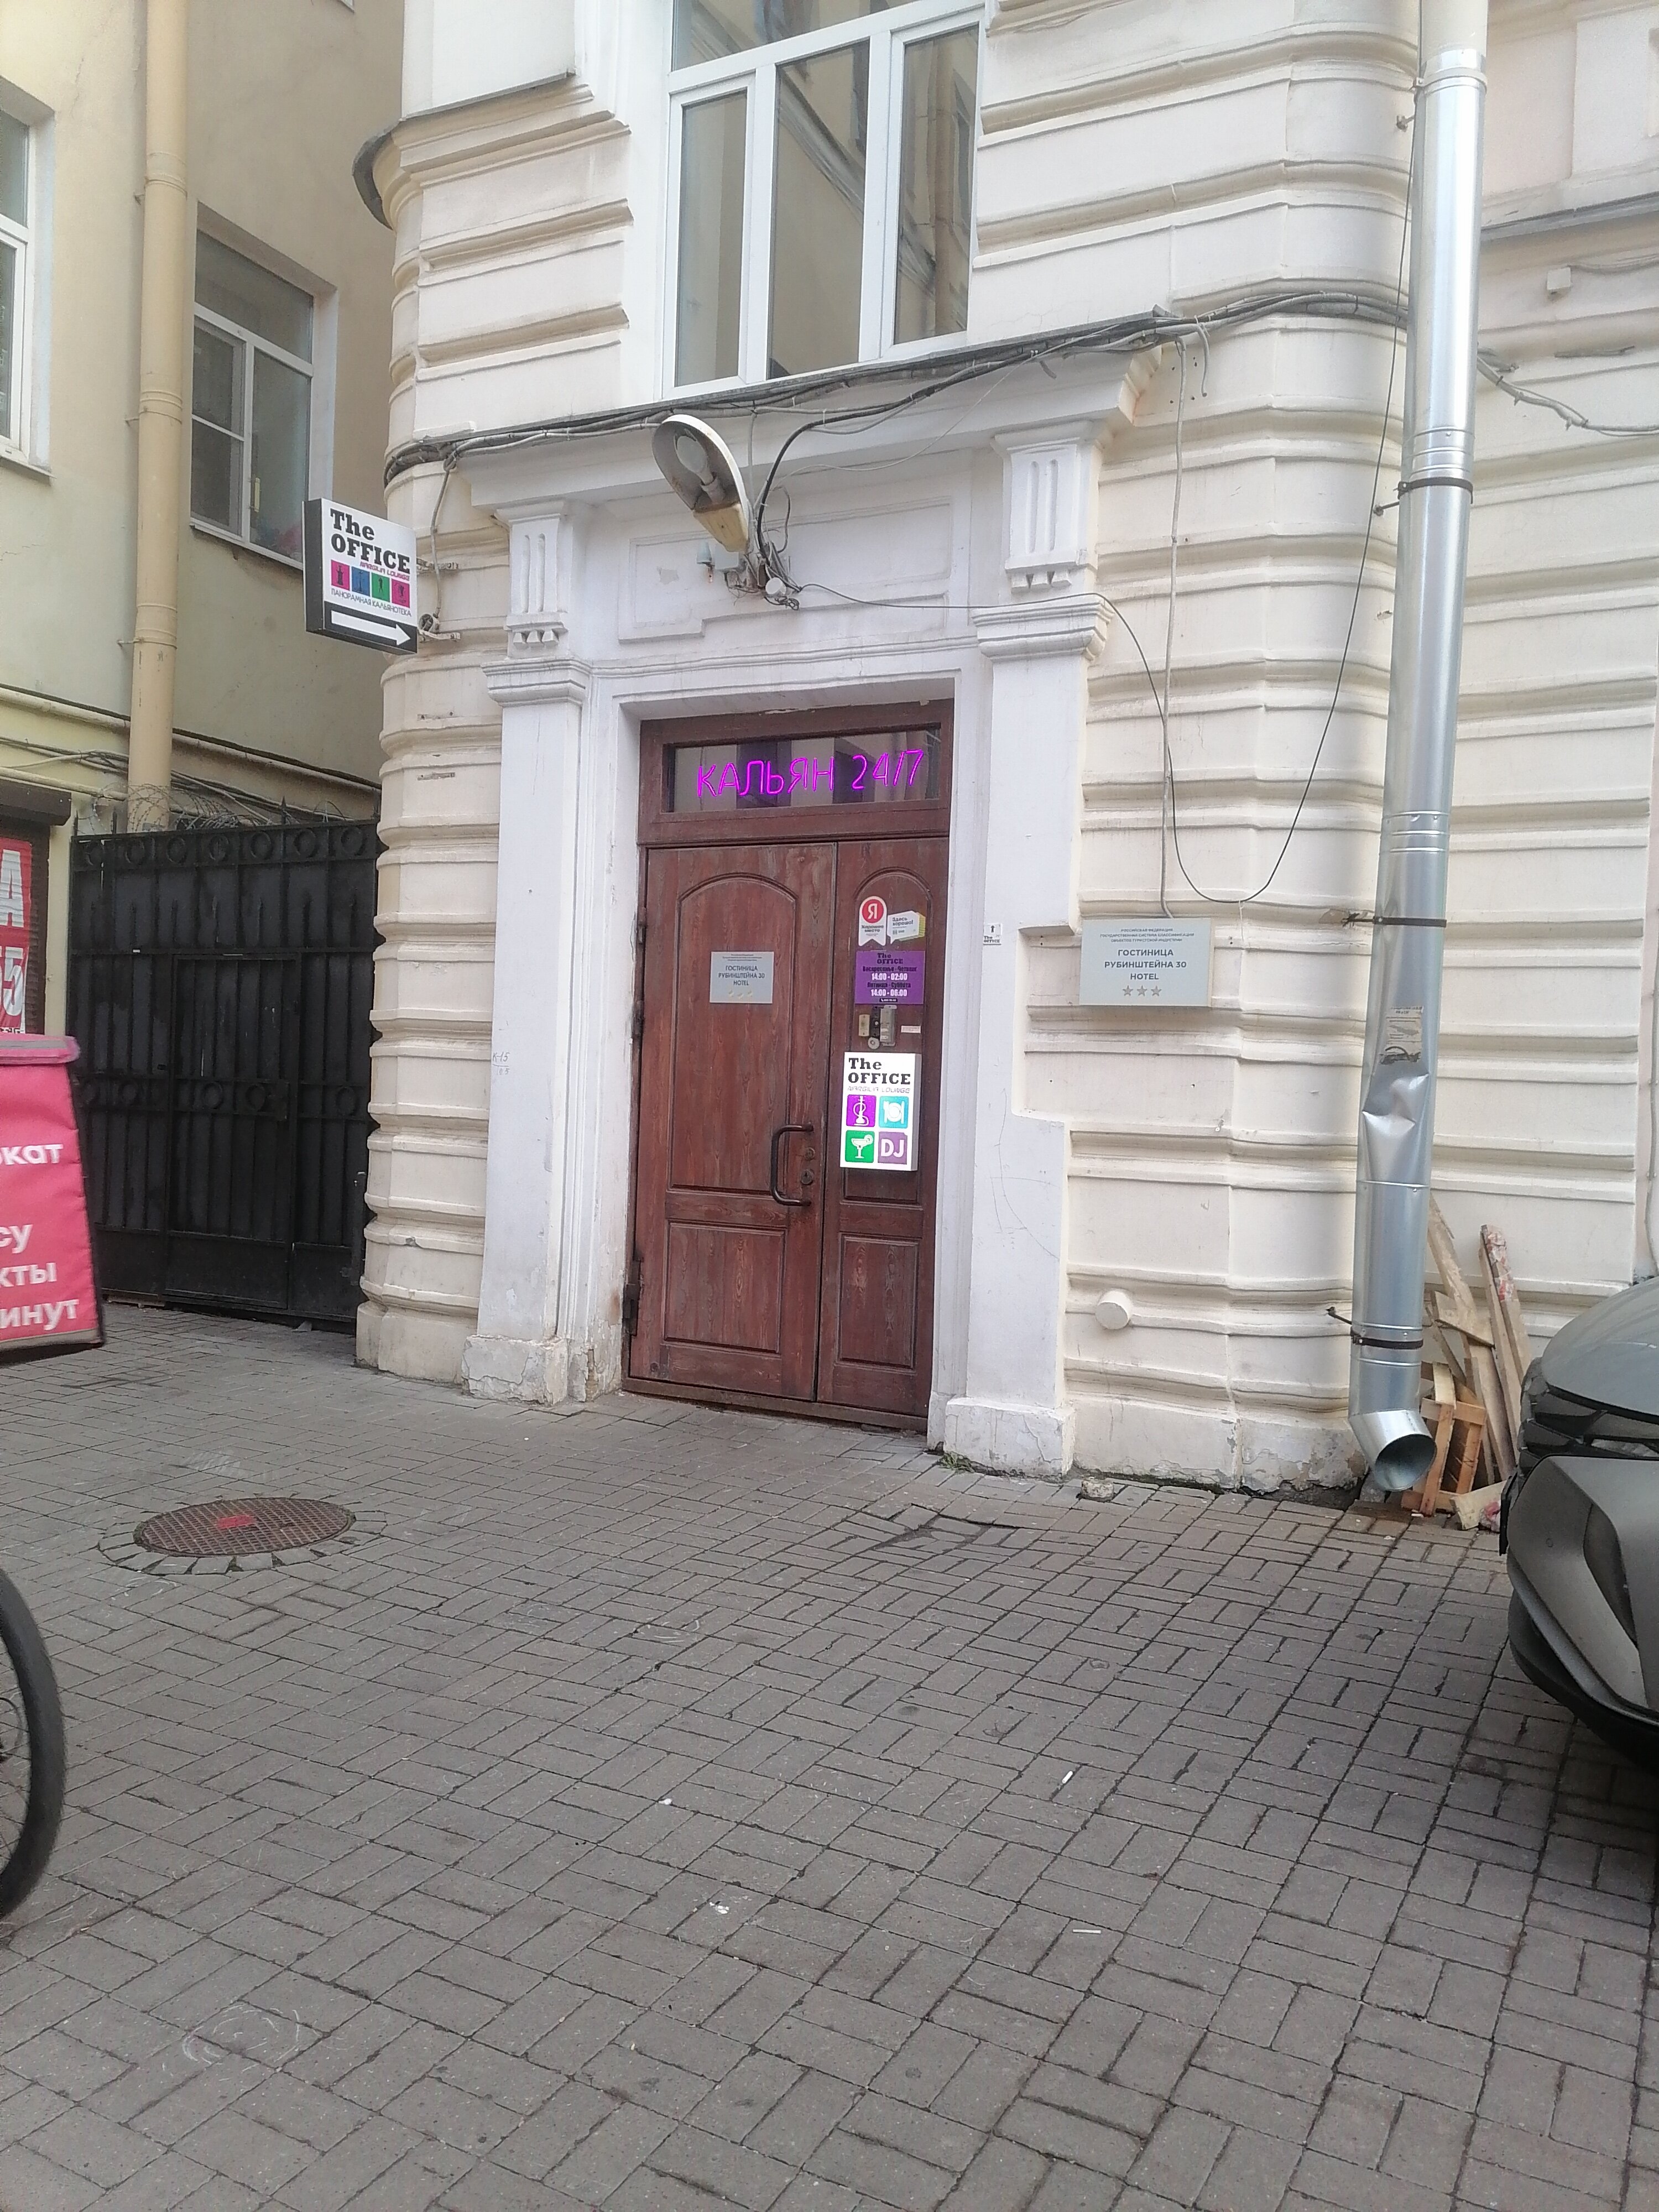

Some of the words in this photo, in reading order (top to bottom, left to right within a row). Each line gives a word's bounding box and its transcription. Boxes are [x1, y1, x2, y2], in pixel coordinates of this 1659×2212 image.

[330, 508, 374, 540] The
[331, 534, 410, 574] OFFICE
[387, 570, 410, 581] LOUNGE
[331, 588, 371, 606] ПАНОРАМНАЯ
[372, 599, 411, 617] КАЛЬЯНОТЕКА
[697, 757, 834, 798] КАЛЬЯН
[852, 749, 924, 791] 24/7
[868, 903, 878, 919] Я
[1105, 959, 1173, 968] РУБИНШТЕЙНА
[849, 1058, 881, 1070] The
[848, 1072, 910, 1084] OFFICE
[0, 1144, 63, 1165] кат
[881, 1139, 904, 1157] DJ
